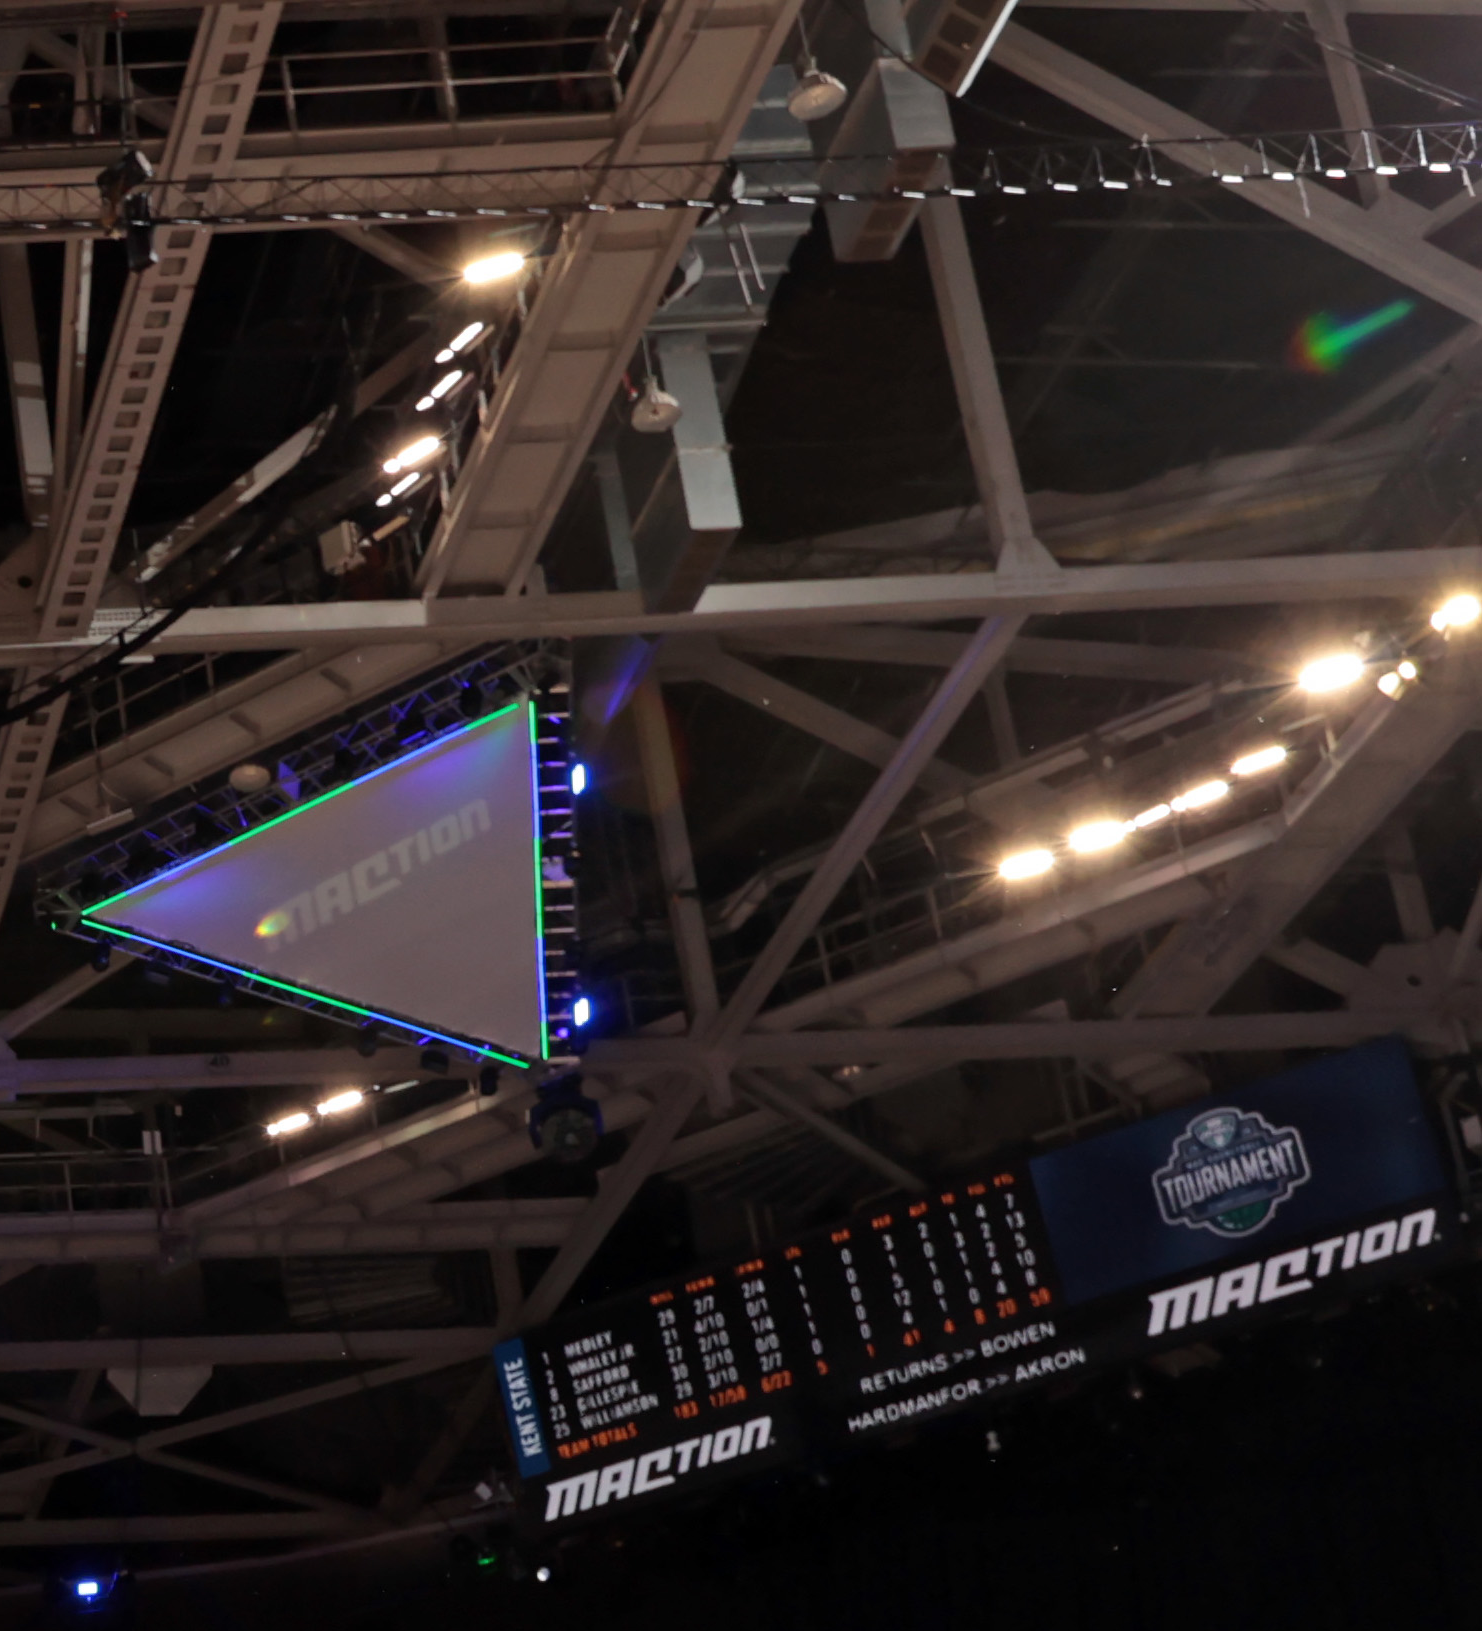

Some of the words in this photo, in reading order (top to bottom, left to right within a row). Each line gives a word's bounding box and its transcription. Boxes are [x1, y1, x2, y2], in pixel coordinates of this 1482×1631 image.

[1162, 1139, 1298, 1214] TOURNAMENT
[1146, 1207, 1436, 1335] MACTION
[503, 1357, 533, 1411] STATE
[847, 1378, 982, 1432] HARDMANFOR
[1014, 1346, 1086, 1382] AKRON
[860, 1353, 948, 1394] RETURNS
[980, 1321, 1056, 1357] BOWEN
[515, 1413, 543, 1458] KENT
[544, 1414, 774, 1521] MACTION
